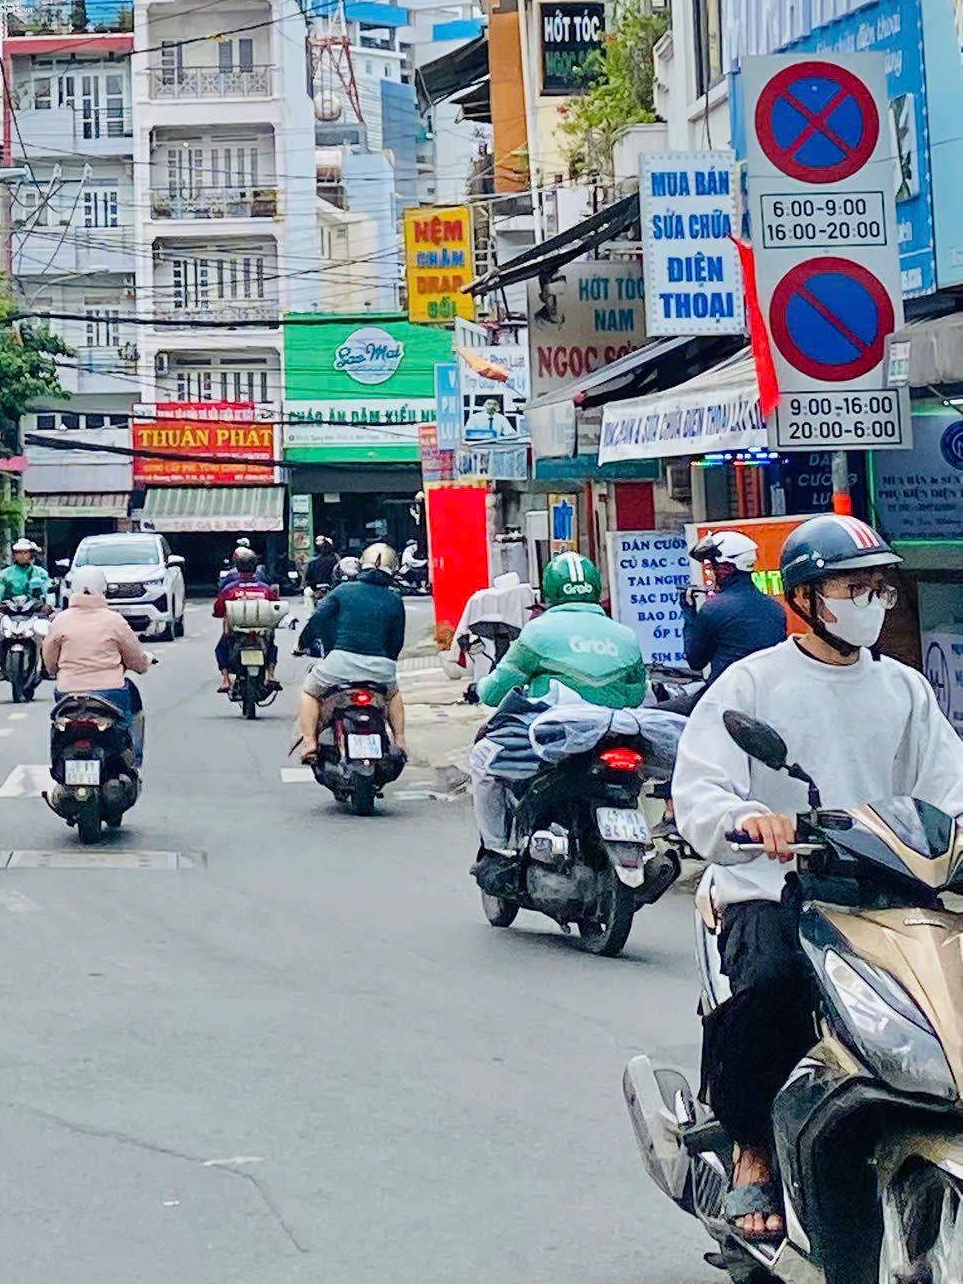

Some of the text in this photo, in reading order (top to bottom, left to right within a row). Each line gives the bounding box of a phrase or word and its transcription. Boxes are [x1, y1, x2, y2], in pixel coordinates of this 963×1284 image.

[573, 9, 600, 42] TÓC
[651, 166, 730, 197] MUA BÁN
[413, 216, 464, 246] NỆM
[653, 208, 733, 240] SỬA CHỮA
[667, 251, 724, 287] ĐIỆN
[659, 292, 734, 323] THOẠI
[594, 308, 635, 333] NAM
[215, 424, 273, 447] PHÁT
[622, 538, 650, 552] DÁN
[641, 557, 668, 571] SẠC
[562, 582, 593, 595] Grab
[627, 574, 691, 587] TAI NGHE
[638, 611, 665, 622] BAO
[653, 625, 671, 638] ỐP
[568, 636, 619, 656] Grab
[651, 652, 673, 662] SIM
